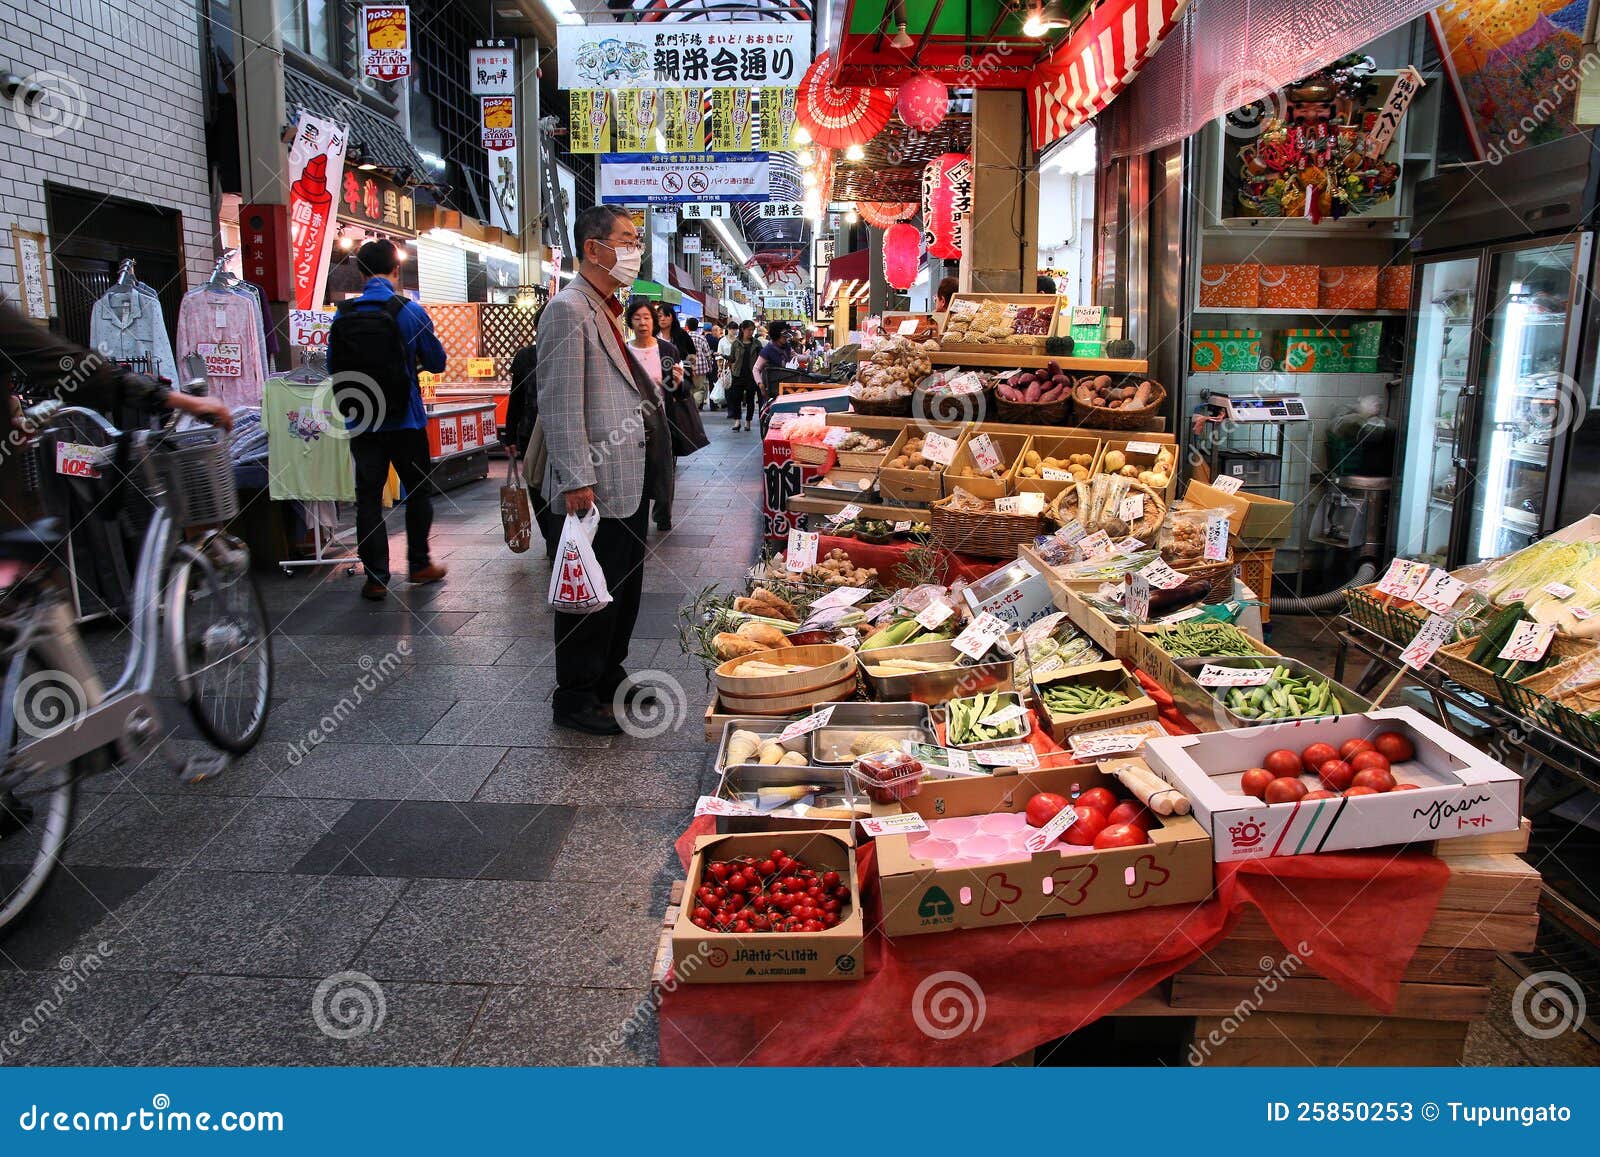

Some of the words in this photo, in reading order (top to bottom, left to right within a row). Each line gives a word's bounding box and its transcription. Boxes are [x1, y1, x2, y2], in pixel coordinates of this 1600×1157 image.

[654, 34, 702, 46] 黒門市場
[368, 56, 407, 64] STAMP
[653, 48, 794, 81] 親栄会通り
[689, 205, 722, 217] 黒門
[1417, 593, 1448, 612] 220
[1458, 814, 1493, 829] トマト
